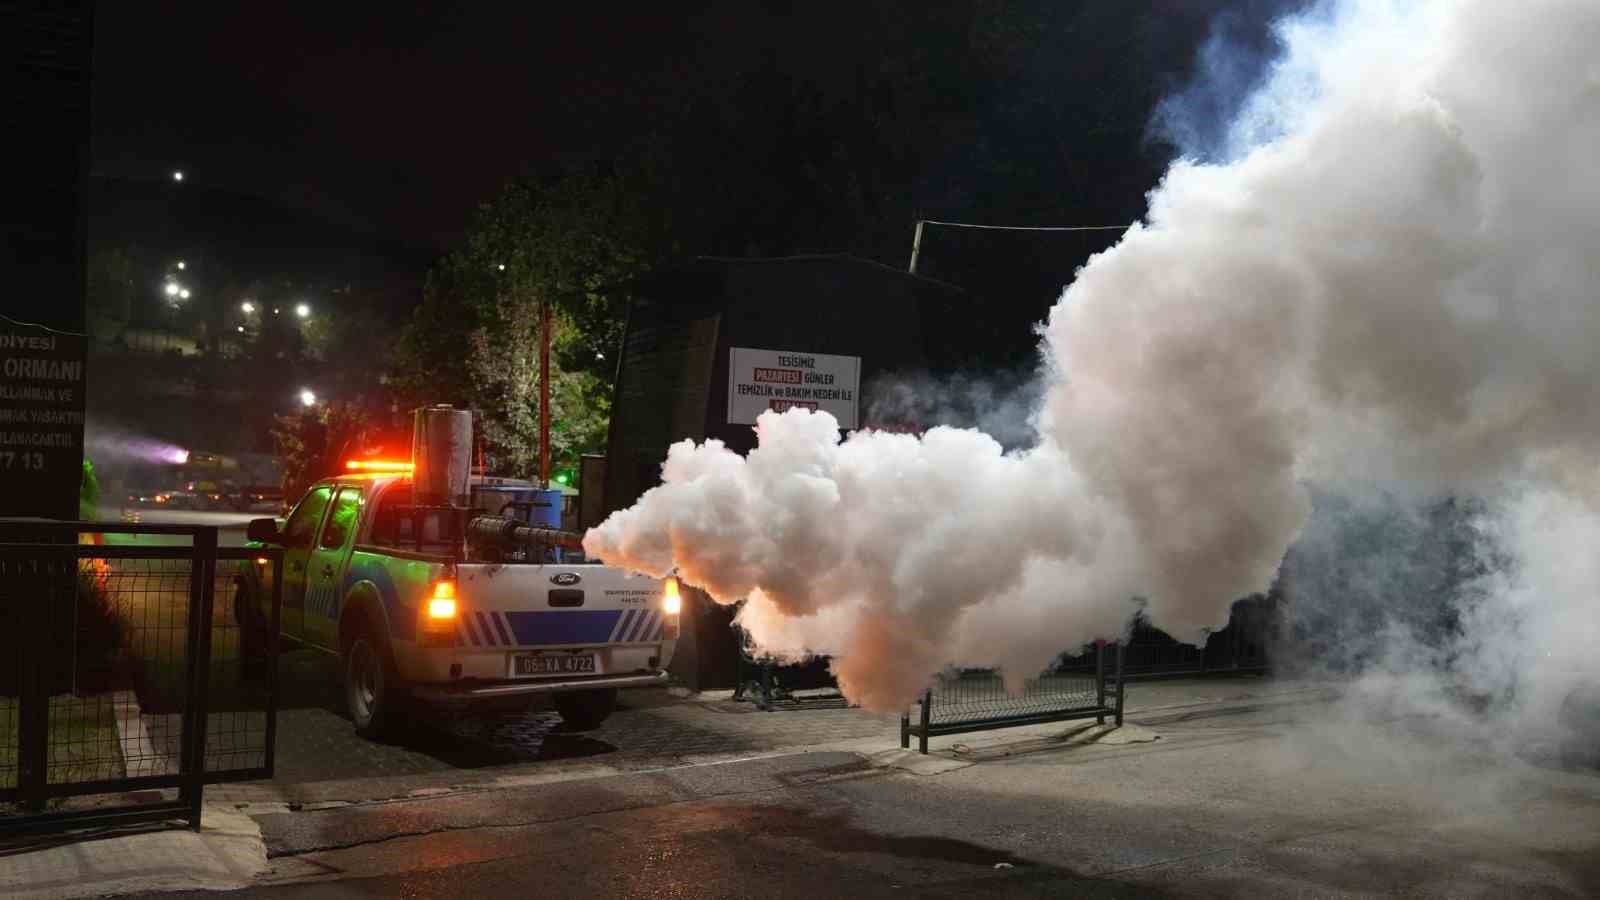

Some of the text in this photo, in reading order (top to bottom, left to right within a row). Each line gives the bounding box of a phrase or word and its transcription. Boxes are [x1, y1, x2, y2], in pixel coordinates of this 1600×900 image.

[4, 358, 81, 381] ORMANI
[778, 355, 816, 368] TESİSİMİZ
[804, 371, 834, 385] GÜNLER
[738, 383, 773, 397] TEMİZLİK
[785, 386, 811, 399] BAKIM
[813, 387, 841, 400] NEDENİ
[524, 657, 538, 673] 06
[565, 656, 593, 671] 4722
